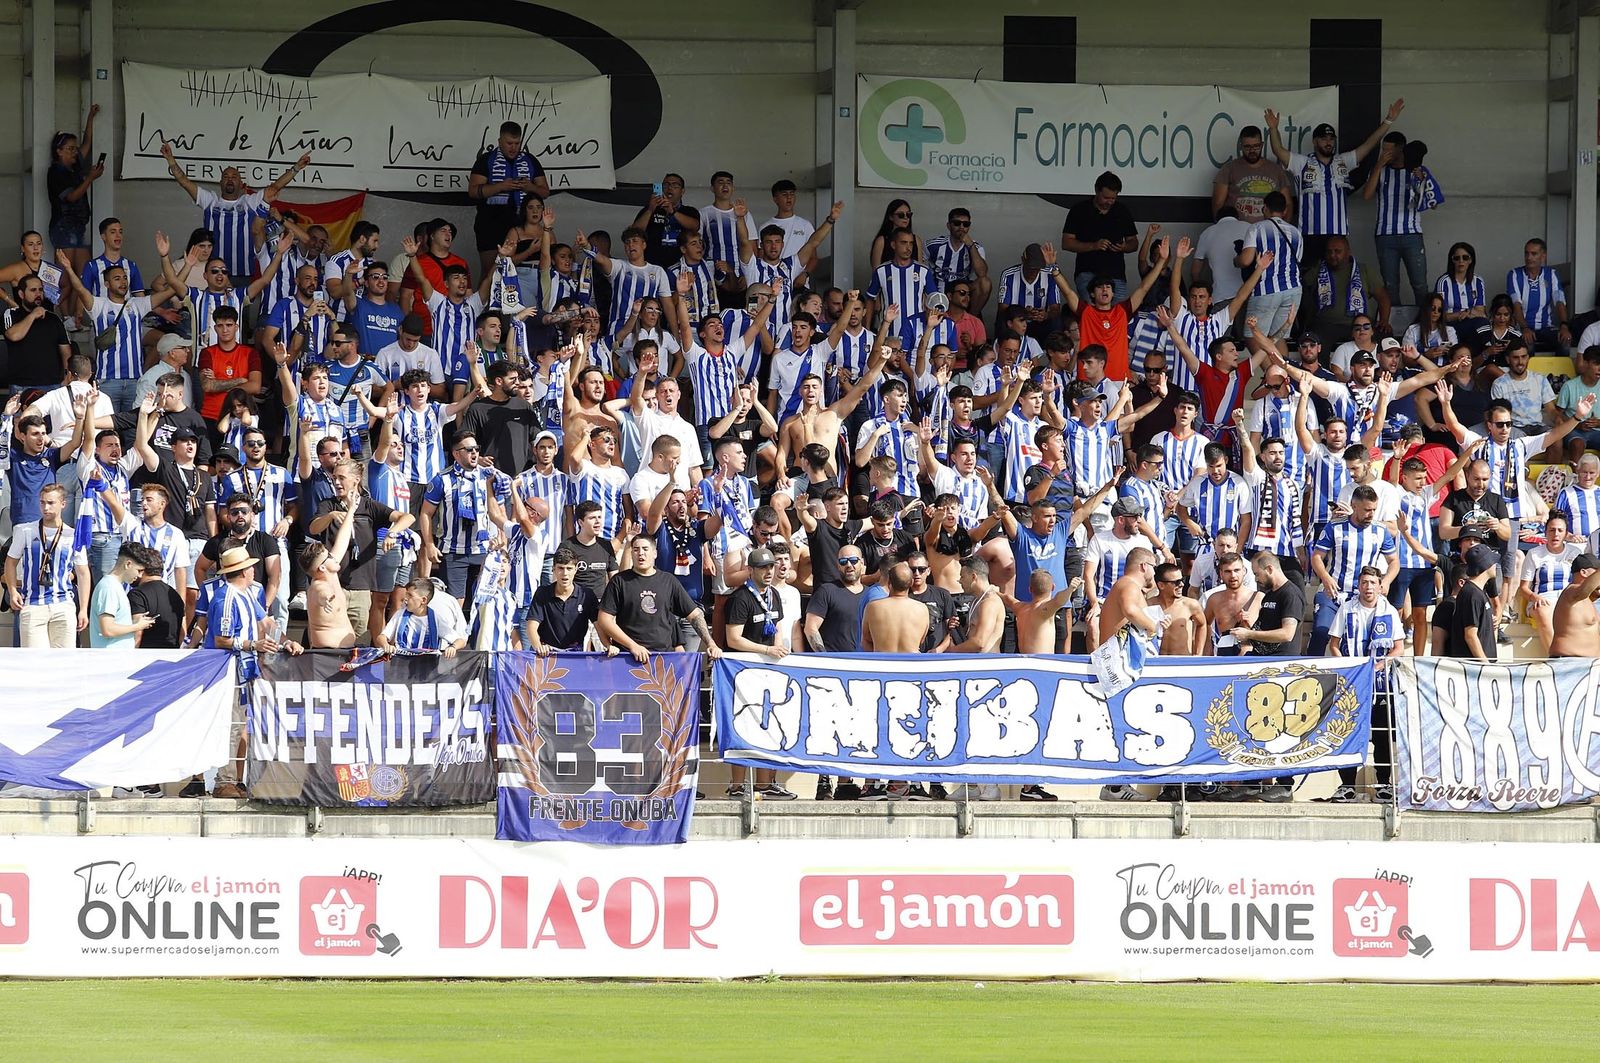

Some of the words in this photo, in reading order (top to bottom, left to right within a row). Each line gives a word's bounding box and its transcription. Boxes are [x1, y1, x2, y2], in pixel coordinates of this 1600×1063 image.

[229, 116, 253, 151] de
[1013, 107, 1195, 169] Farmacia
[929, 151, 1006, 168] Farmacia
[947, 167, 1005, 183] Centro
[250, 677, 487, 765] OFFENDERS
[1245, 674, 1325, 742] 83
[536, 692, 663, 796] 83
[1395, 657, 1563, 810] 1889
[1232, 753, 1277, 766] FRENTE
[1281, 744, 1330, 764] ONUBA
[1413, 776, 1483, 803] Forza
[1488, 778, 1561, 803] Recre
[529, 796, 604, 821] FRENTE
[610, 797, 678, 822] ONUBA
[74, 861, 121, 904] Tu
[116, 862, 187, 903] Compra
[191, 876, 209, 894] el
[213, 876, 281, 898] jamón
[342, 865, 383, 886] ¡APP!
[1116, 863, 1160, 906] Tu
[1156, 864, 1224, 904] Compra
[1228, 878, 1246, 896] el
[1251, 878, 1315, 900] jamón
[1374, 868, 1414, 889] ¡APP!
[78, 901, 280, 940] ONLINE
[812, 879, 863, 929] el
[876, 874, 1062, 941] jamón
[327, 911, 346, 932] ej
[1120, 901, 1314, 941] ONLINE
[1360, 911, 1379, 933] ej
[82, 945, 280, 957] www.supermercadoseljamon.com
[314, 938, 324, 948] el
[325, 936, 361, 950] jamón
[1124, 946, 1314, 958] www.supermercadoseljamon.com
[1348, 938, 1358, 949] el
[1358, 937, 1393, 951] jamón
